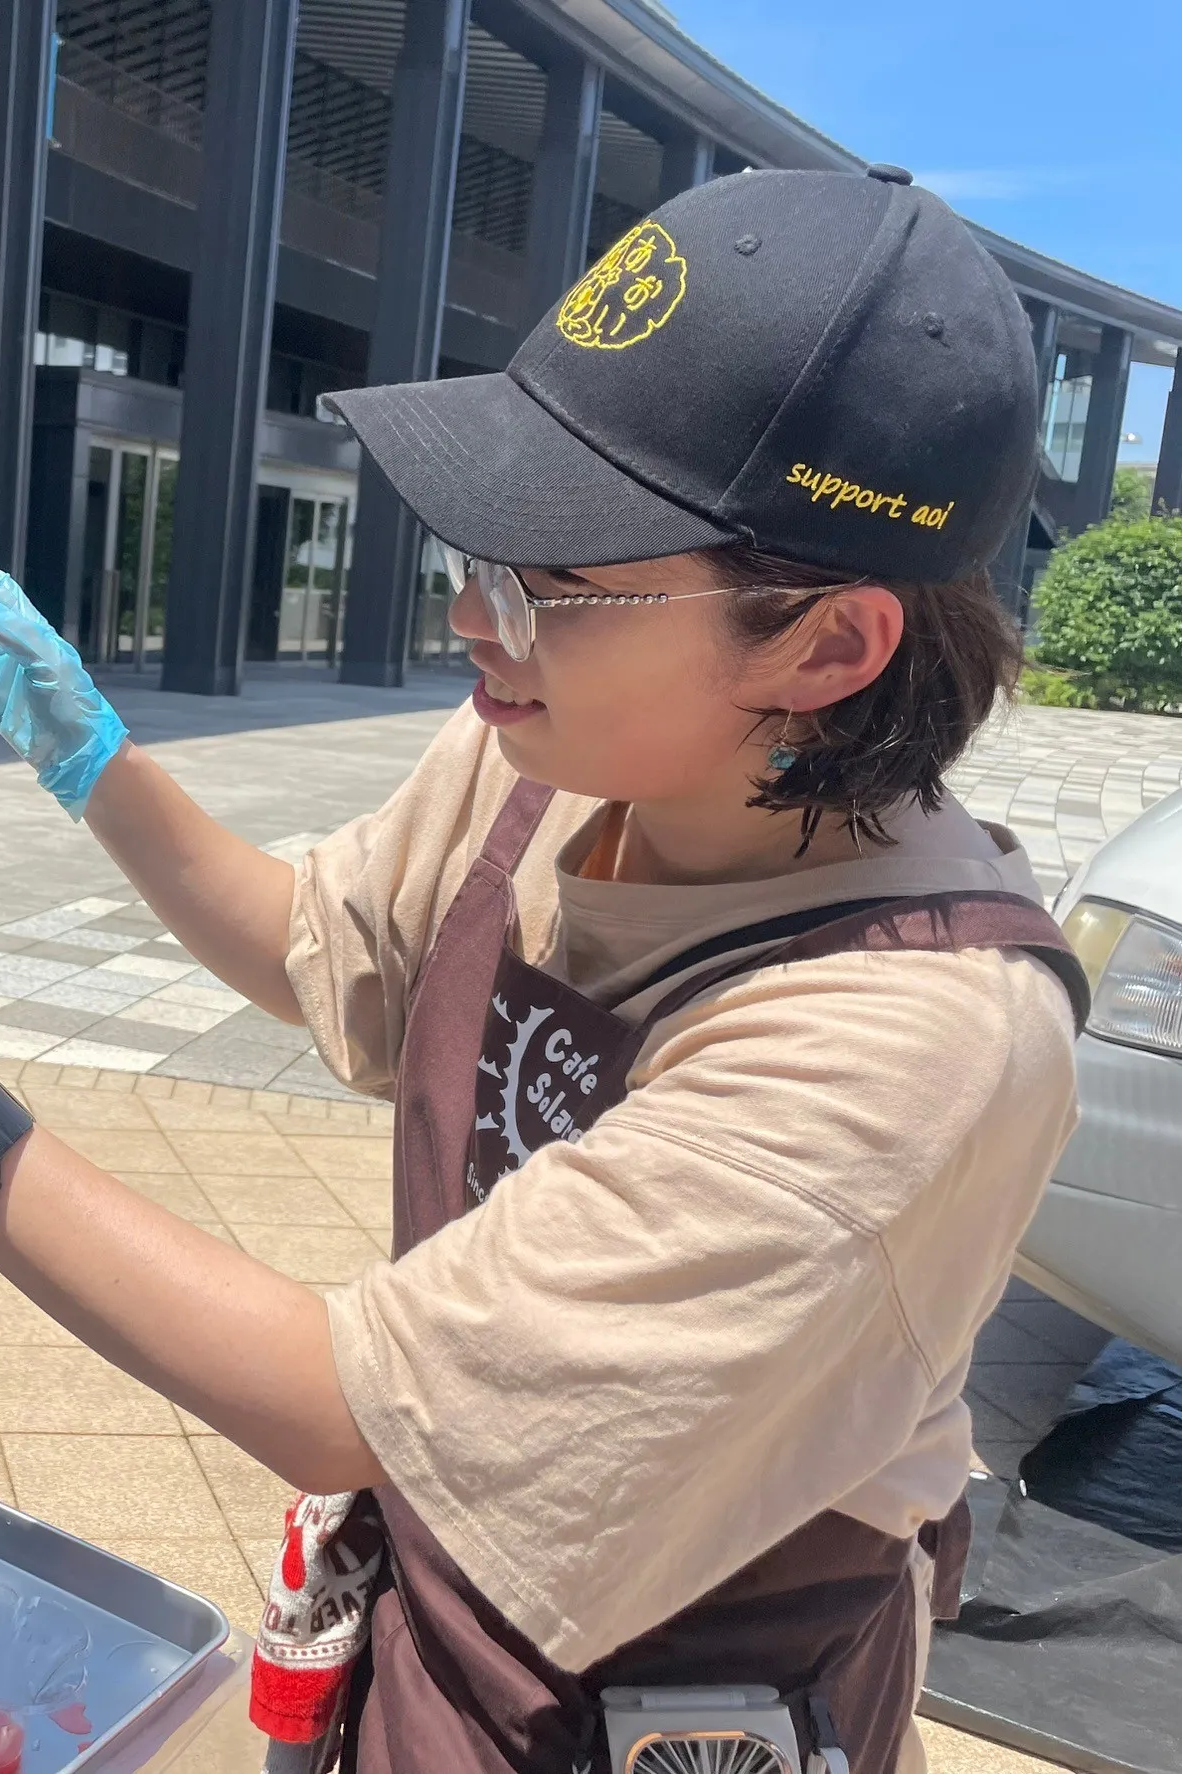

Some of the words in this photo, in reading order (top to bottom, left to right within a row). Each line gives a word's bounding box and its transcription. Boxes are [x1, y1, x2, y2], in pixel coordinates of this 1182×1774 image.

[785, 462, 908, 519] support
[911, 501, 955, 531] aoi
[545, 1028, 599, 1095] Cafe
[467, 1162, 490, 1203] Sinc
